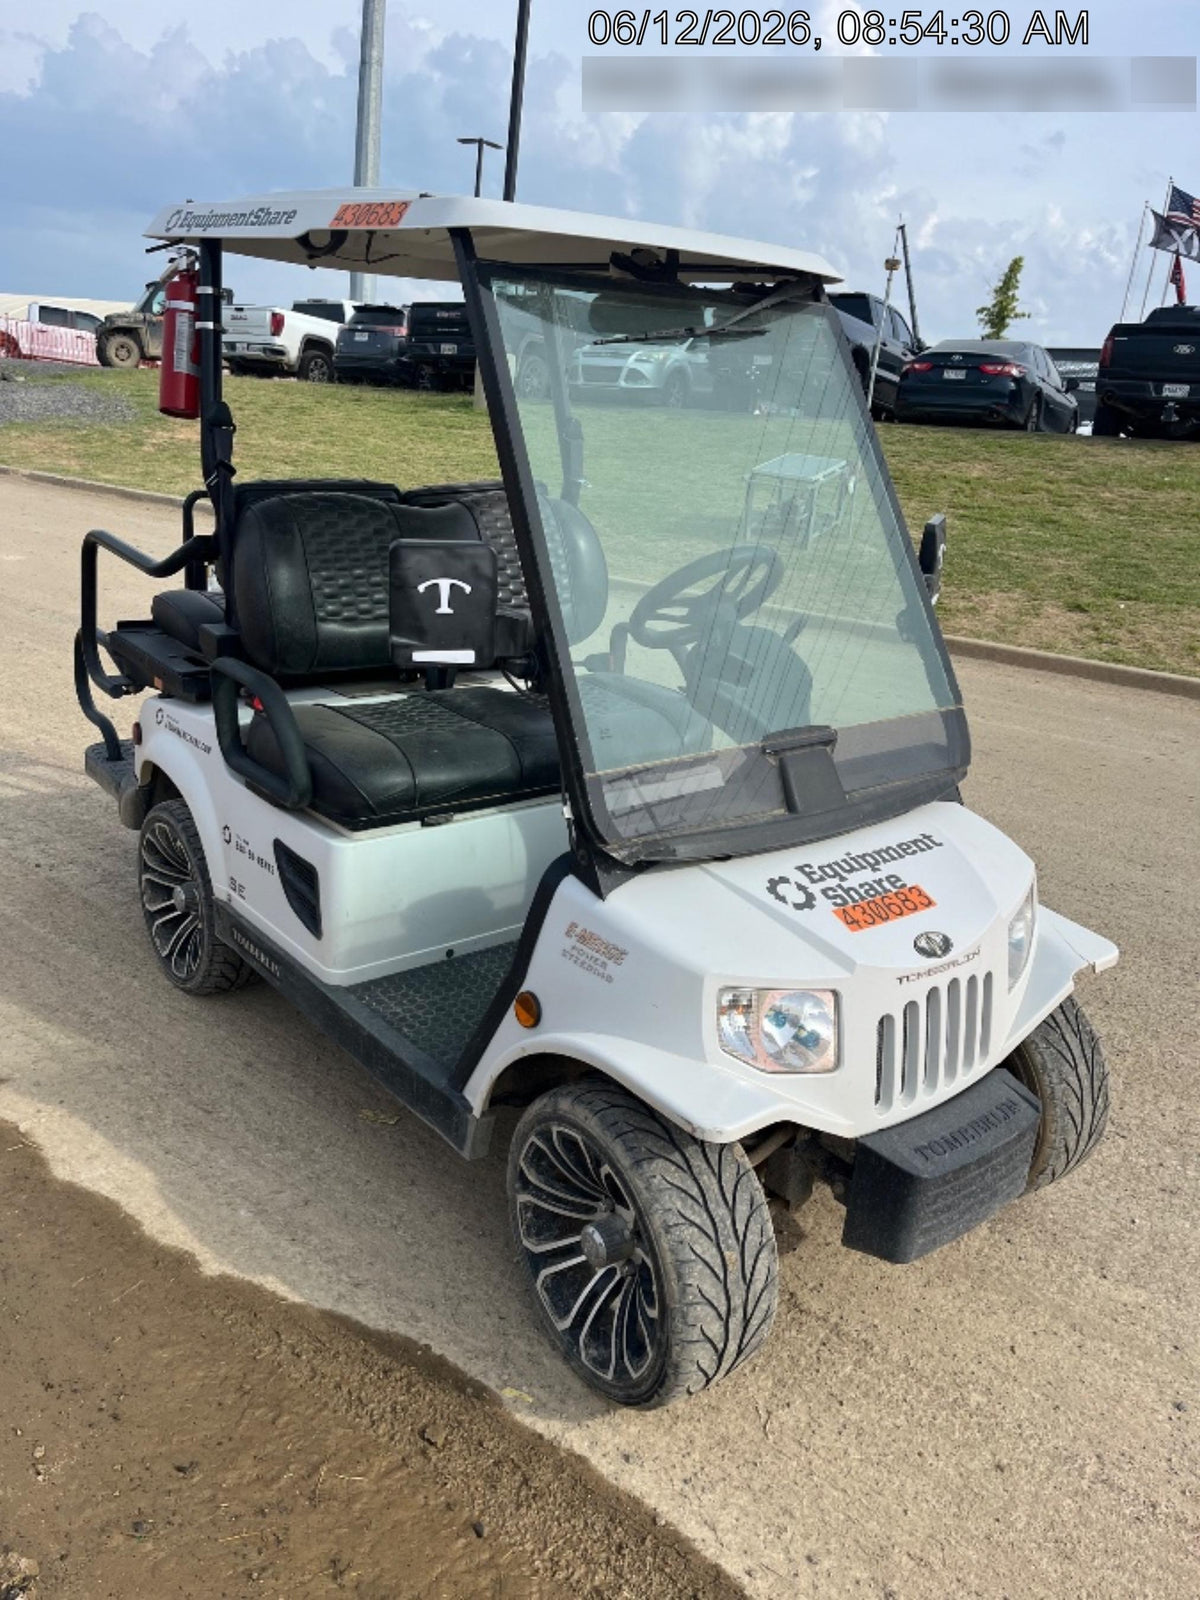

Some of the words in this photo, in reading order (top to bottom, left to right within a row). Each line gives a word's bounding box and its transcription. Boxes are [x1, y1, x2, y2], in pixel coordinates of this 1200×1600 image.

[179, 207, 297, 232] EquipmentShare
[334, 201, 409, 226] 430683
[795, 833, 944, 885] Equipment
[820, 874, 908, 907] Share
[841, 886, 934, 930] 430683
